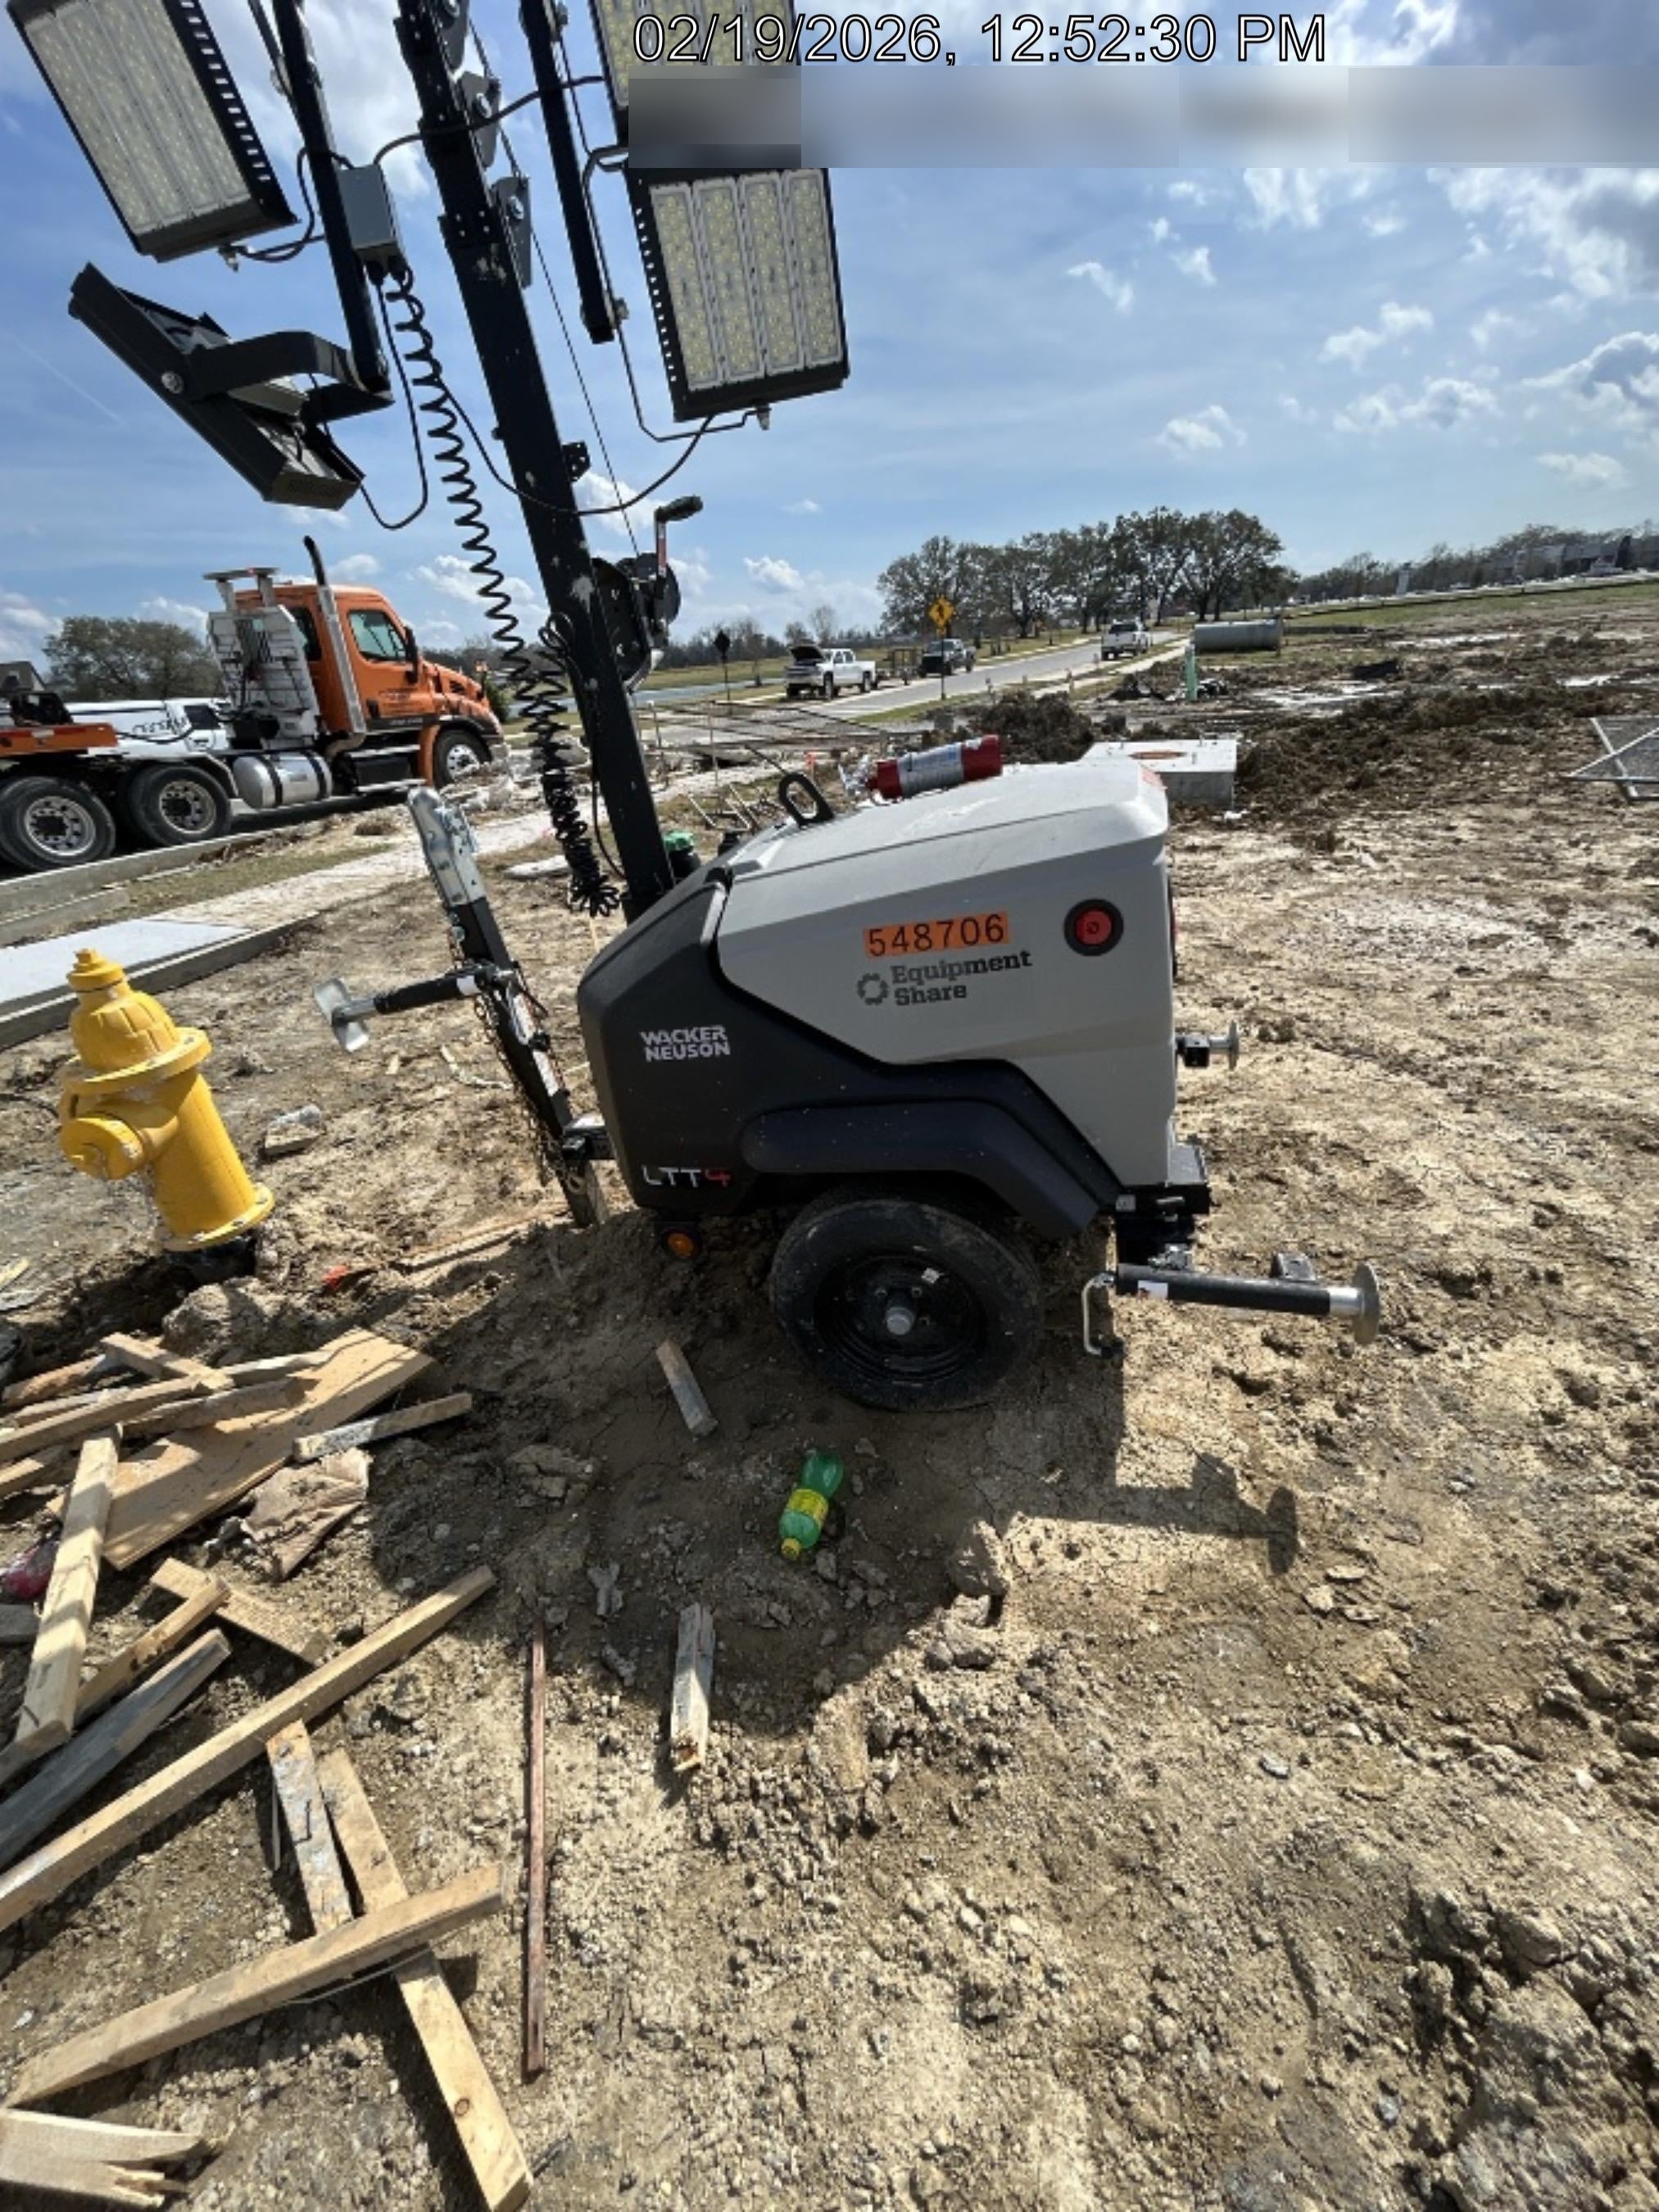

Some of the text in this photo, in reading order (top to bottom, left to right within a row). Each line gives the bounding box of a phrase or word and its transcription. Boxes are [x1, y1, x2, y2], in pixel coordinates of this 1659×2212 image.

[868, 913, 1004, 957] 548706
[891, 950, 1033, 986] Equipment
[894, 984, 968, 1006] Share
[640, 1025, 728, 1045] WACKER
[644, 1041, 731, 1063] NEUSON
[641, 1164, 732, 1188] LTT4
